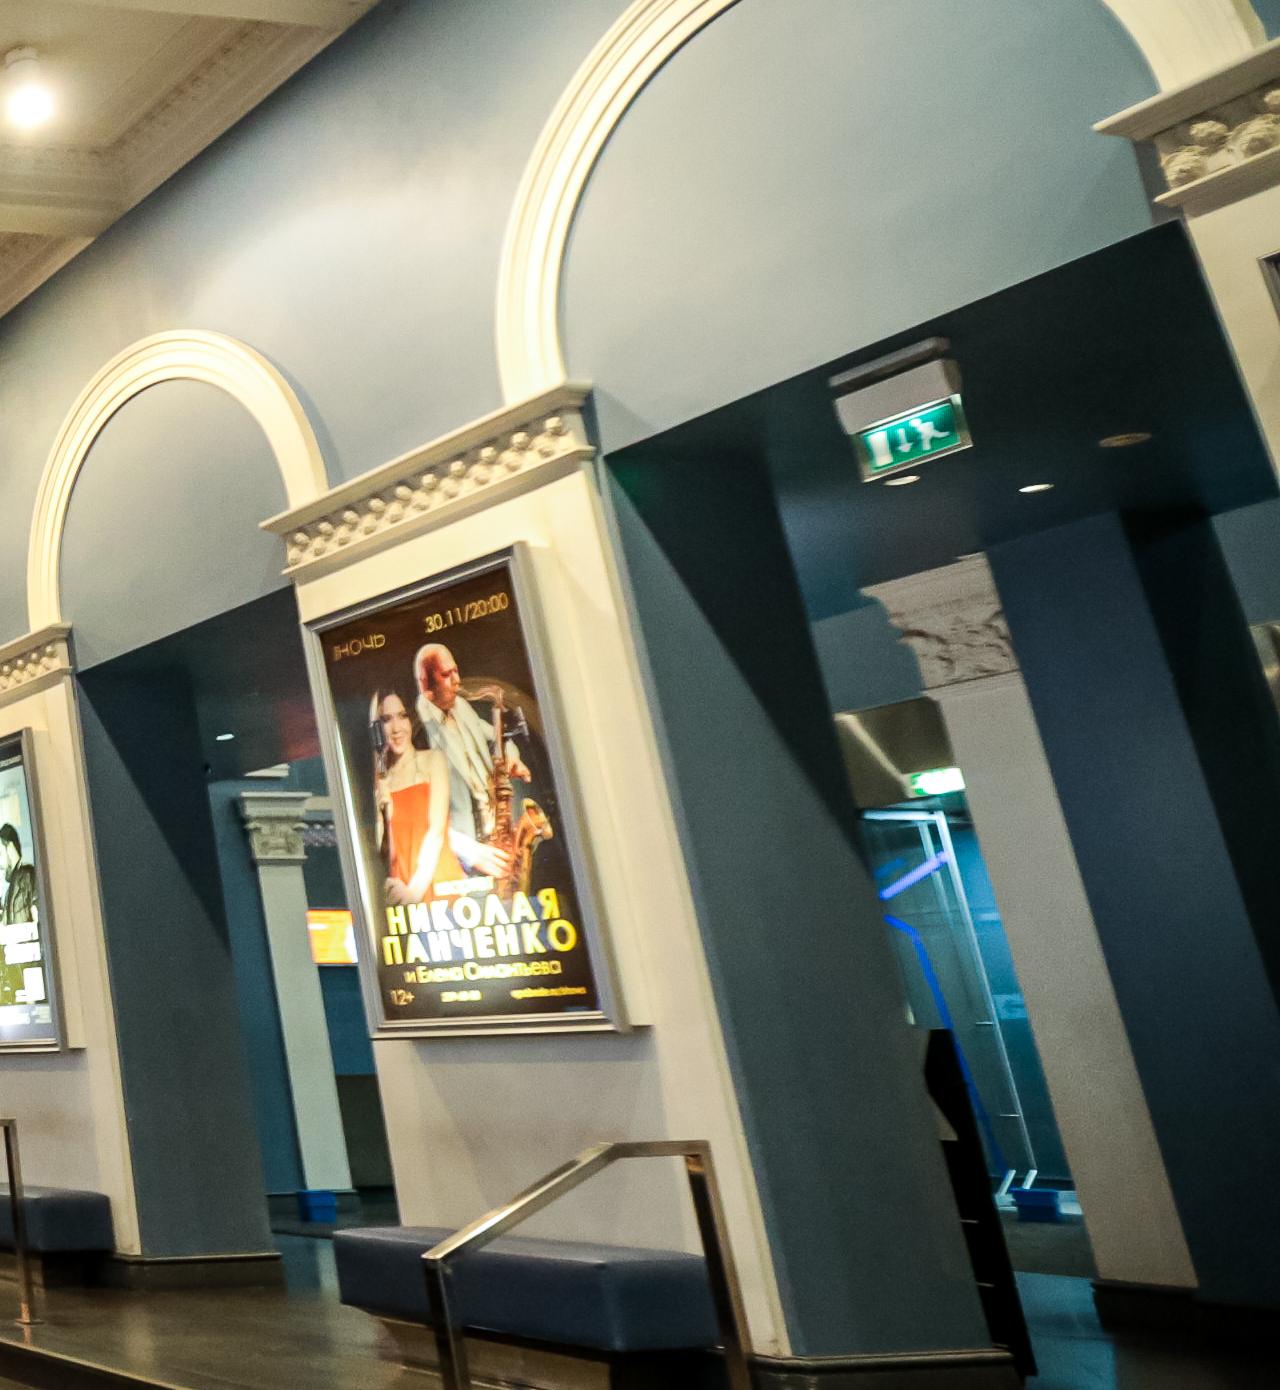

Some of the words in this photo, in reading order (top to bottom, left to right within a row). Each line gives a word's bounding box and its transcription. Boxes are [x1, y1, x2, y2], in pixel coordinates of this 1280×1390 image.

[425, 592, 508, 633] 30.11/20:00
[386, 887, 561, 935] НИКОЛАЯ
[382, 919, 578, 966] ПАНЧЕНКО
[391, 989, 415, 1006] 12+
